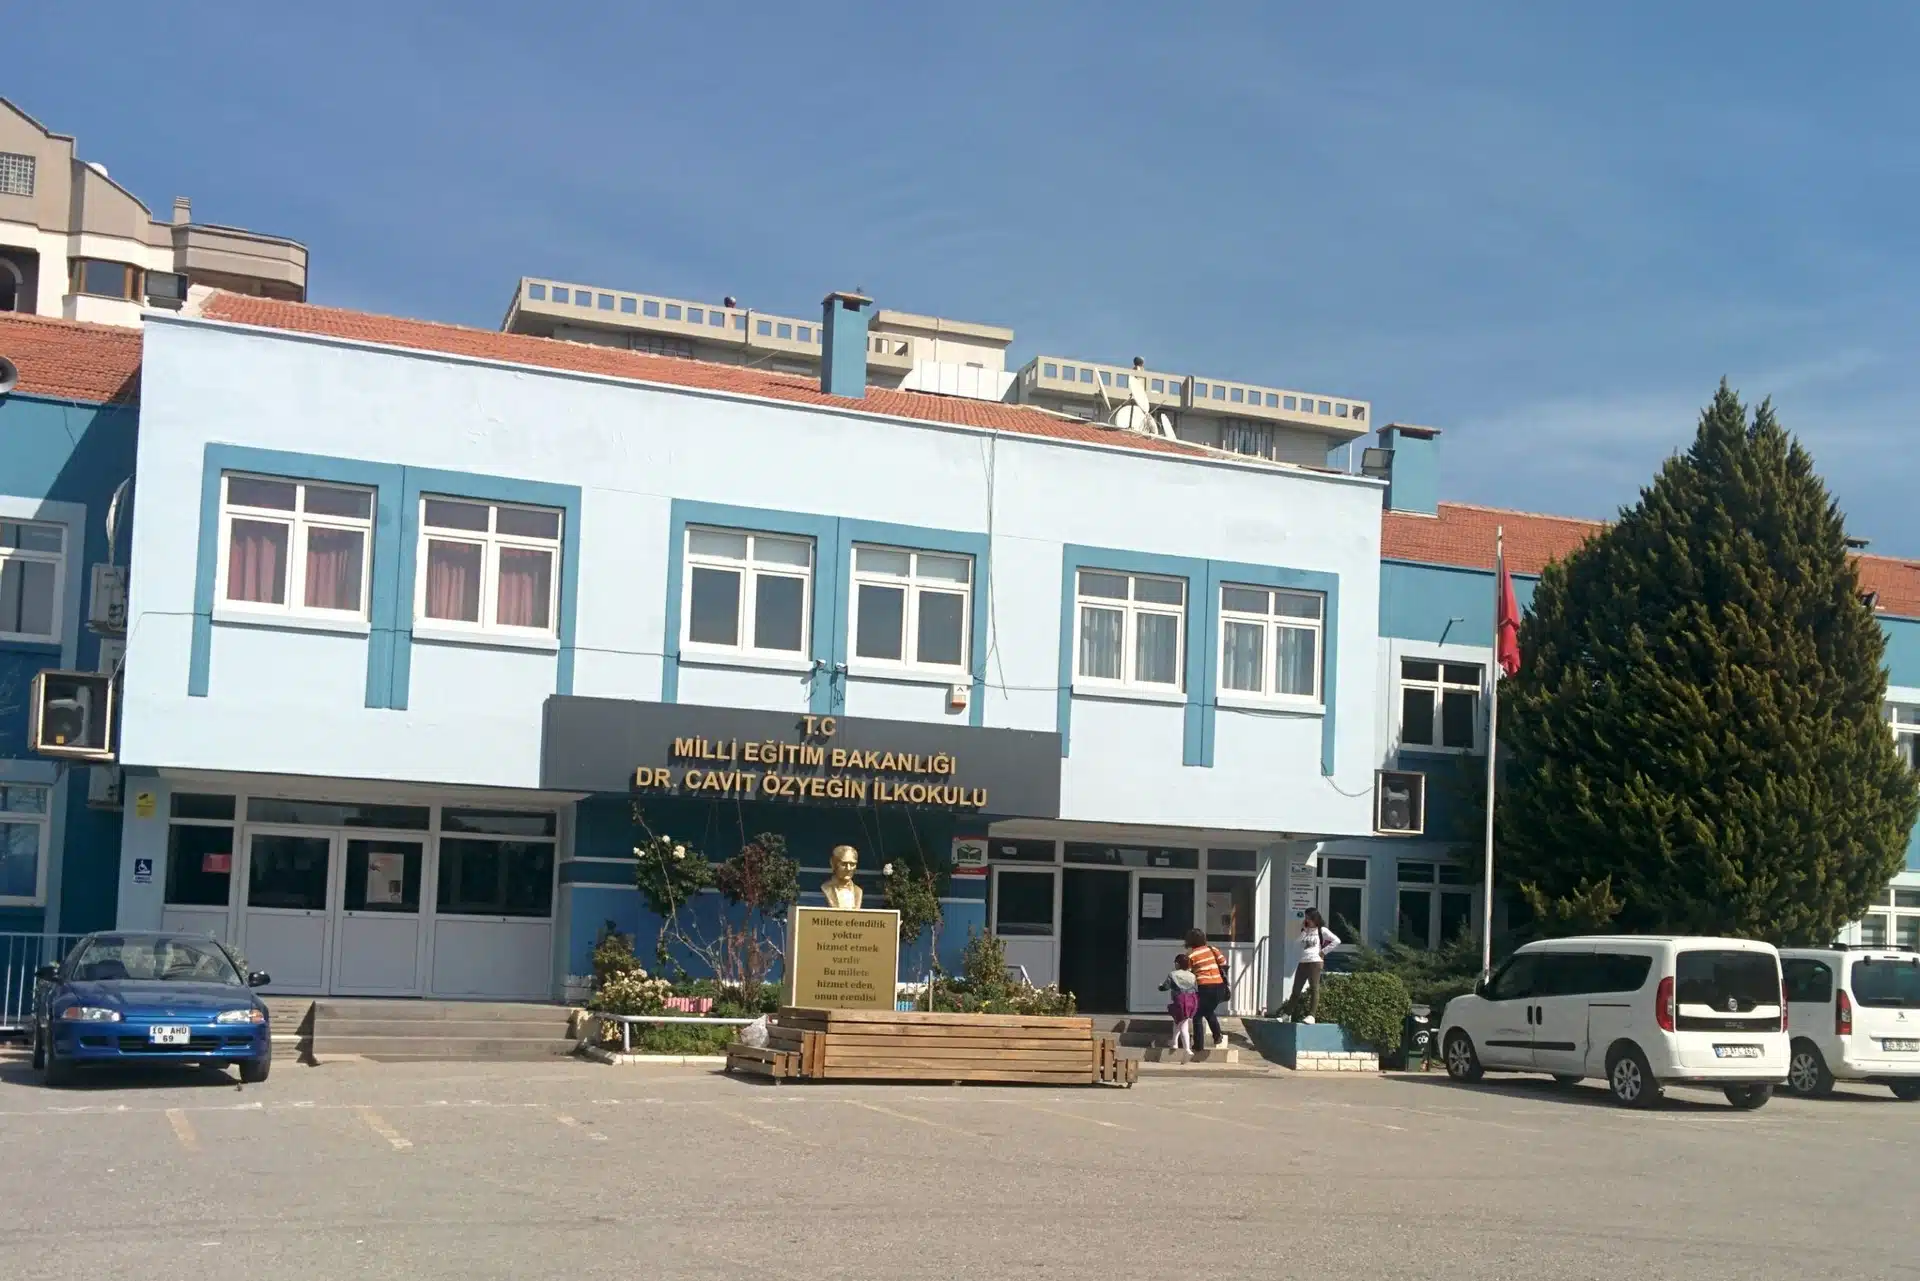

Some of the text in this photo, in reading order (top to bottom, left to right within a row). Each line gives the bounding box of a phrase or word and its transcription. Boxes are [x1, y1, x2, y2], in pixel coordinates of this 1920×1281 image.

[803, 715, 836, 736] T.C
[674, 735, 956, 775] MİLLİ EĞİTİM BAKANLIĞI
[636, 766, 988, 807] DR. CAVİT ÖZYEĞİN İLKOKULU
[812, 917, 887, 929] Millete efendilik
[832, 931, 863, 940] yoktur
[816, 942, 879, 953] hizmet etmek
[823, 967, 836, 976] Bu
[817, 979, 849, 989] hizmet
[814, 993, 837, 1001] onun
